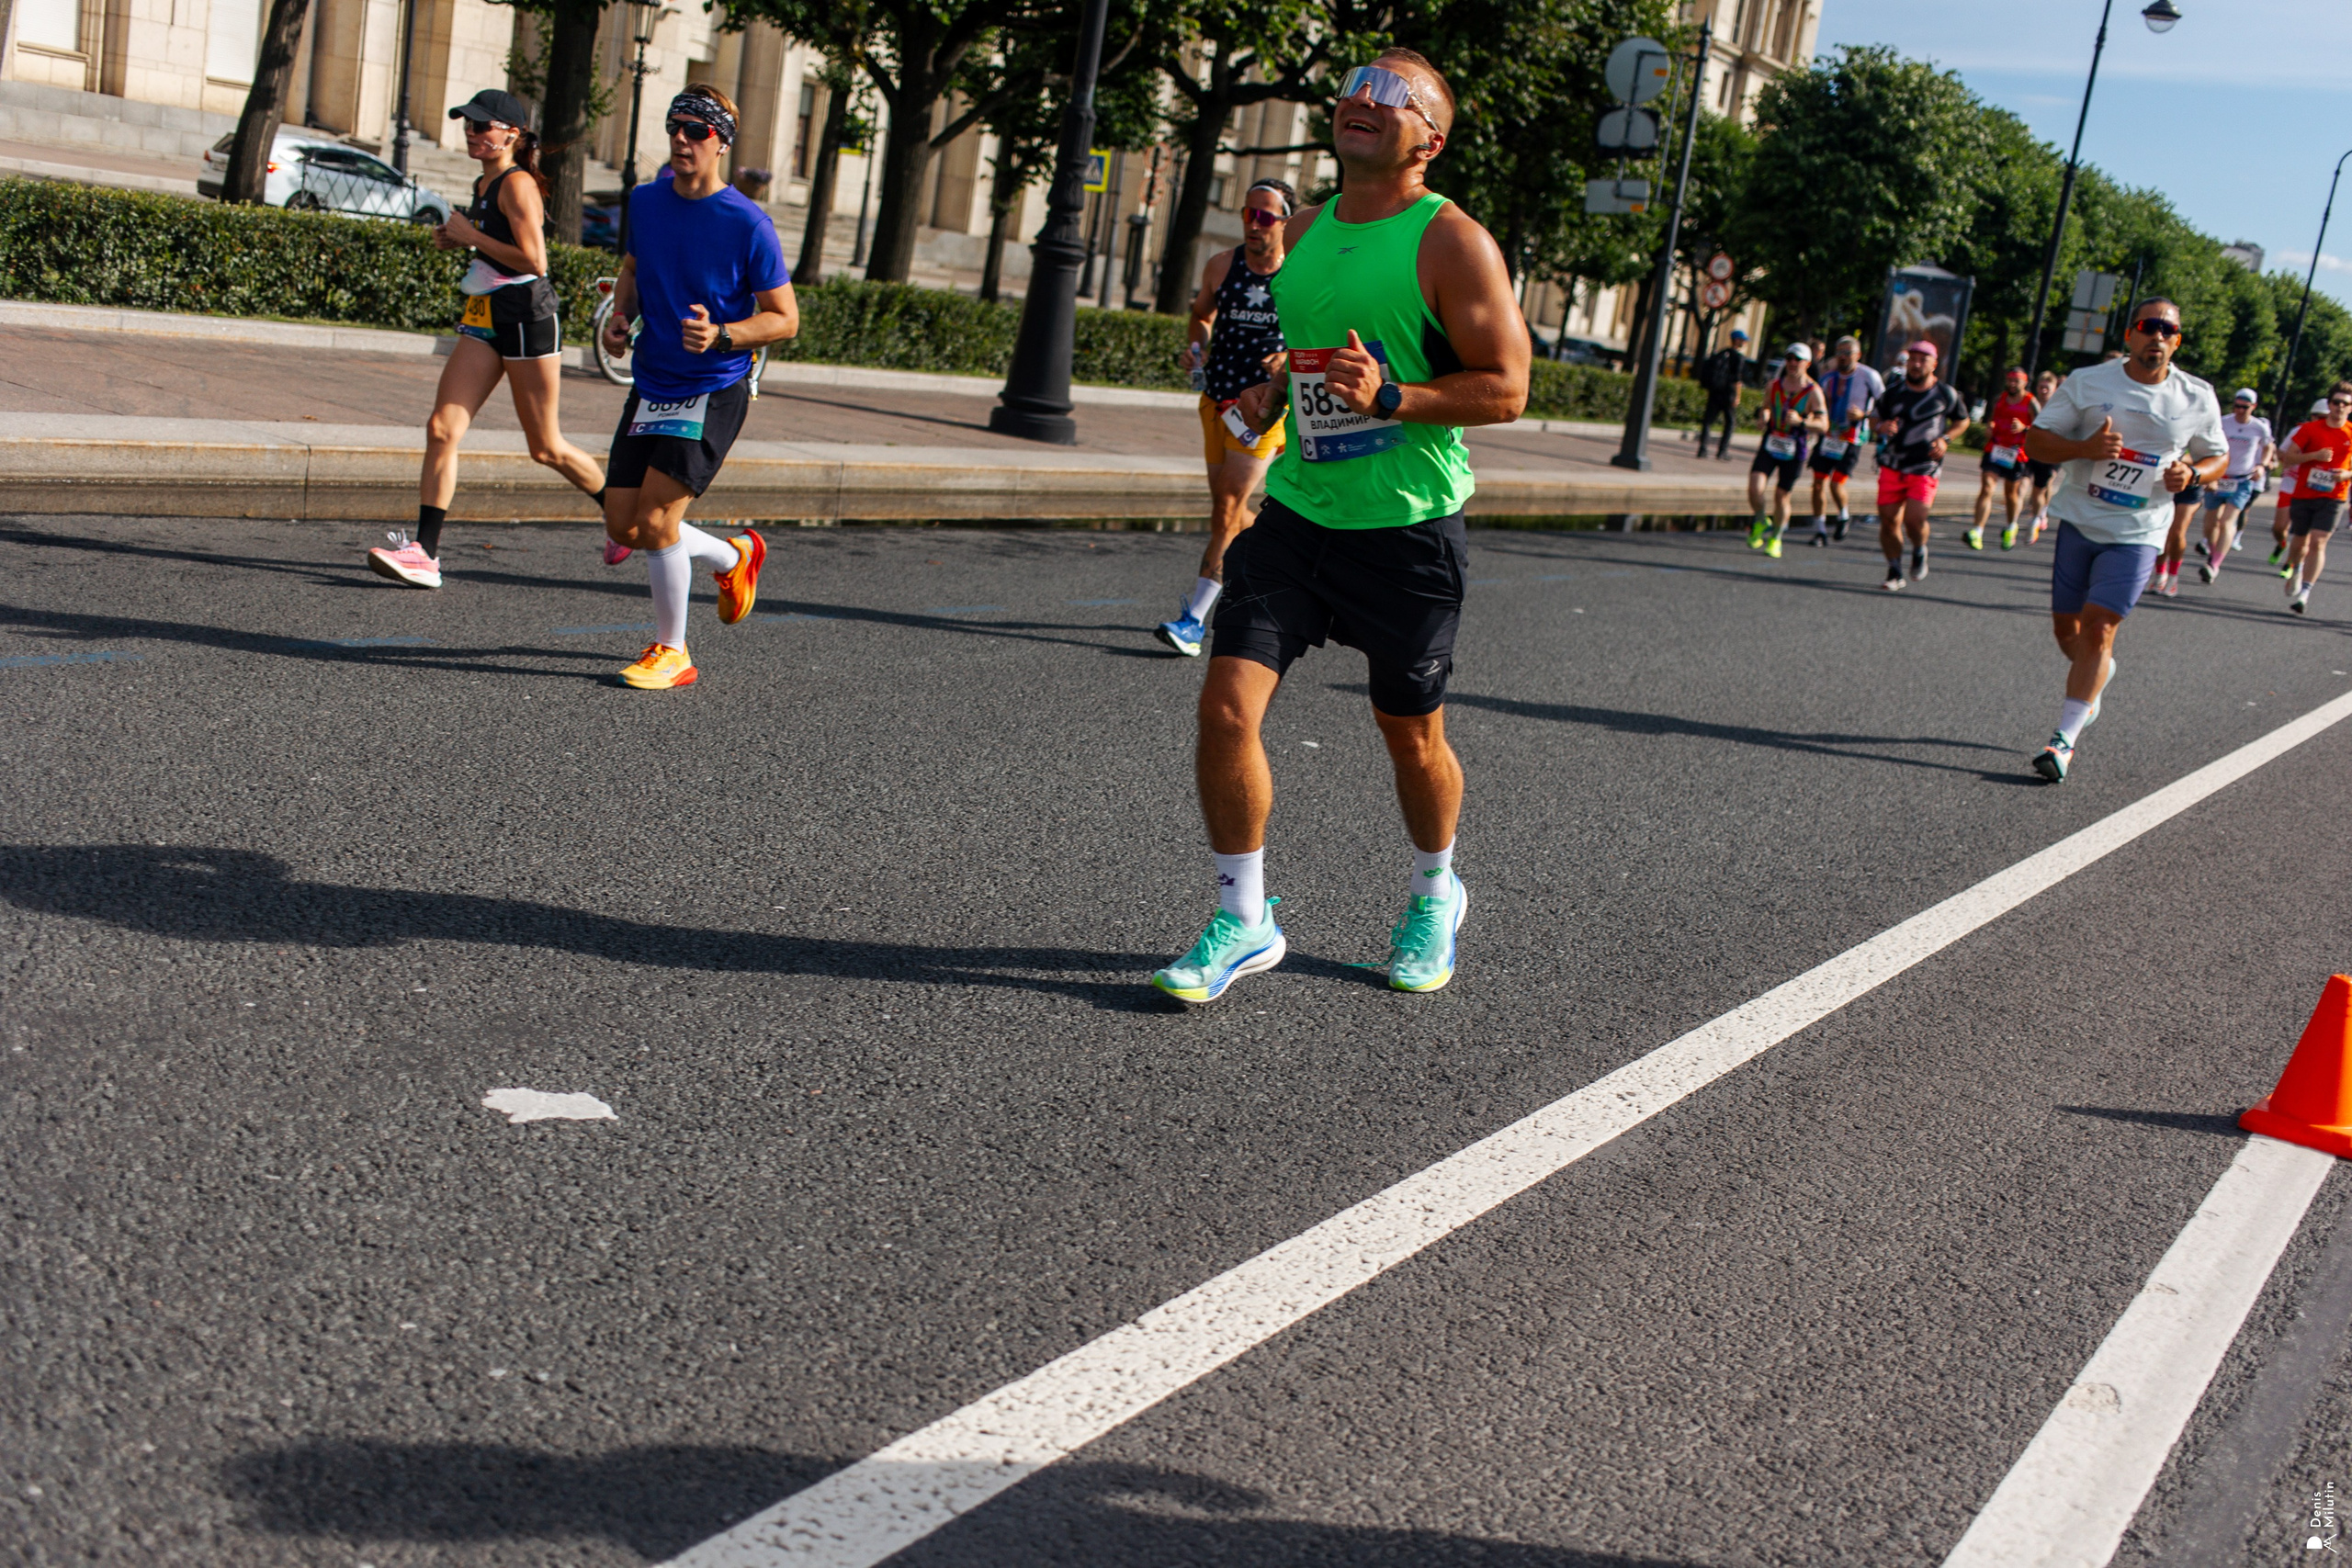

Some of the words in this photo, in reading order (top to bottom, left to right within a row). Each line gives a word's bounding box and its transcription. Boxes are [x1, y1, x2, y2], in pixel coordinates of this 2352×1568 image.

[1229, 309, 1279, 323] SAYSKY
[1311, 414, 1371, 430] ВЛАДИМИР
[2105, 461, 2143, 485] 277
